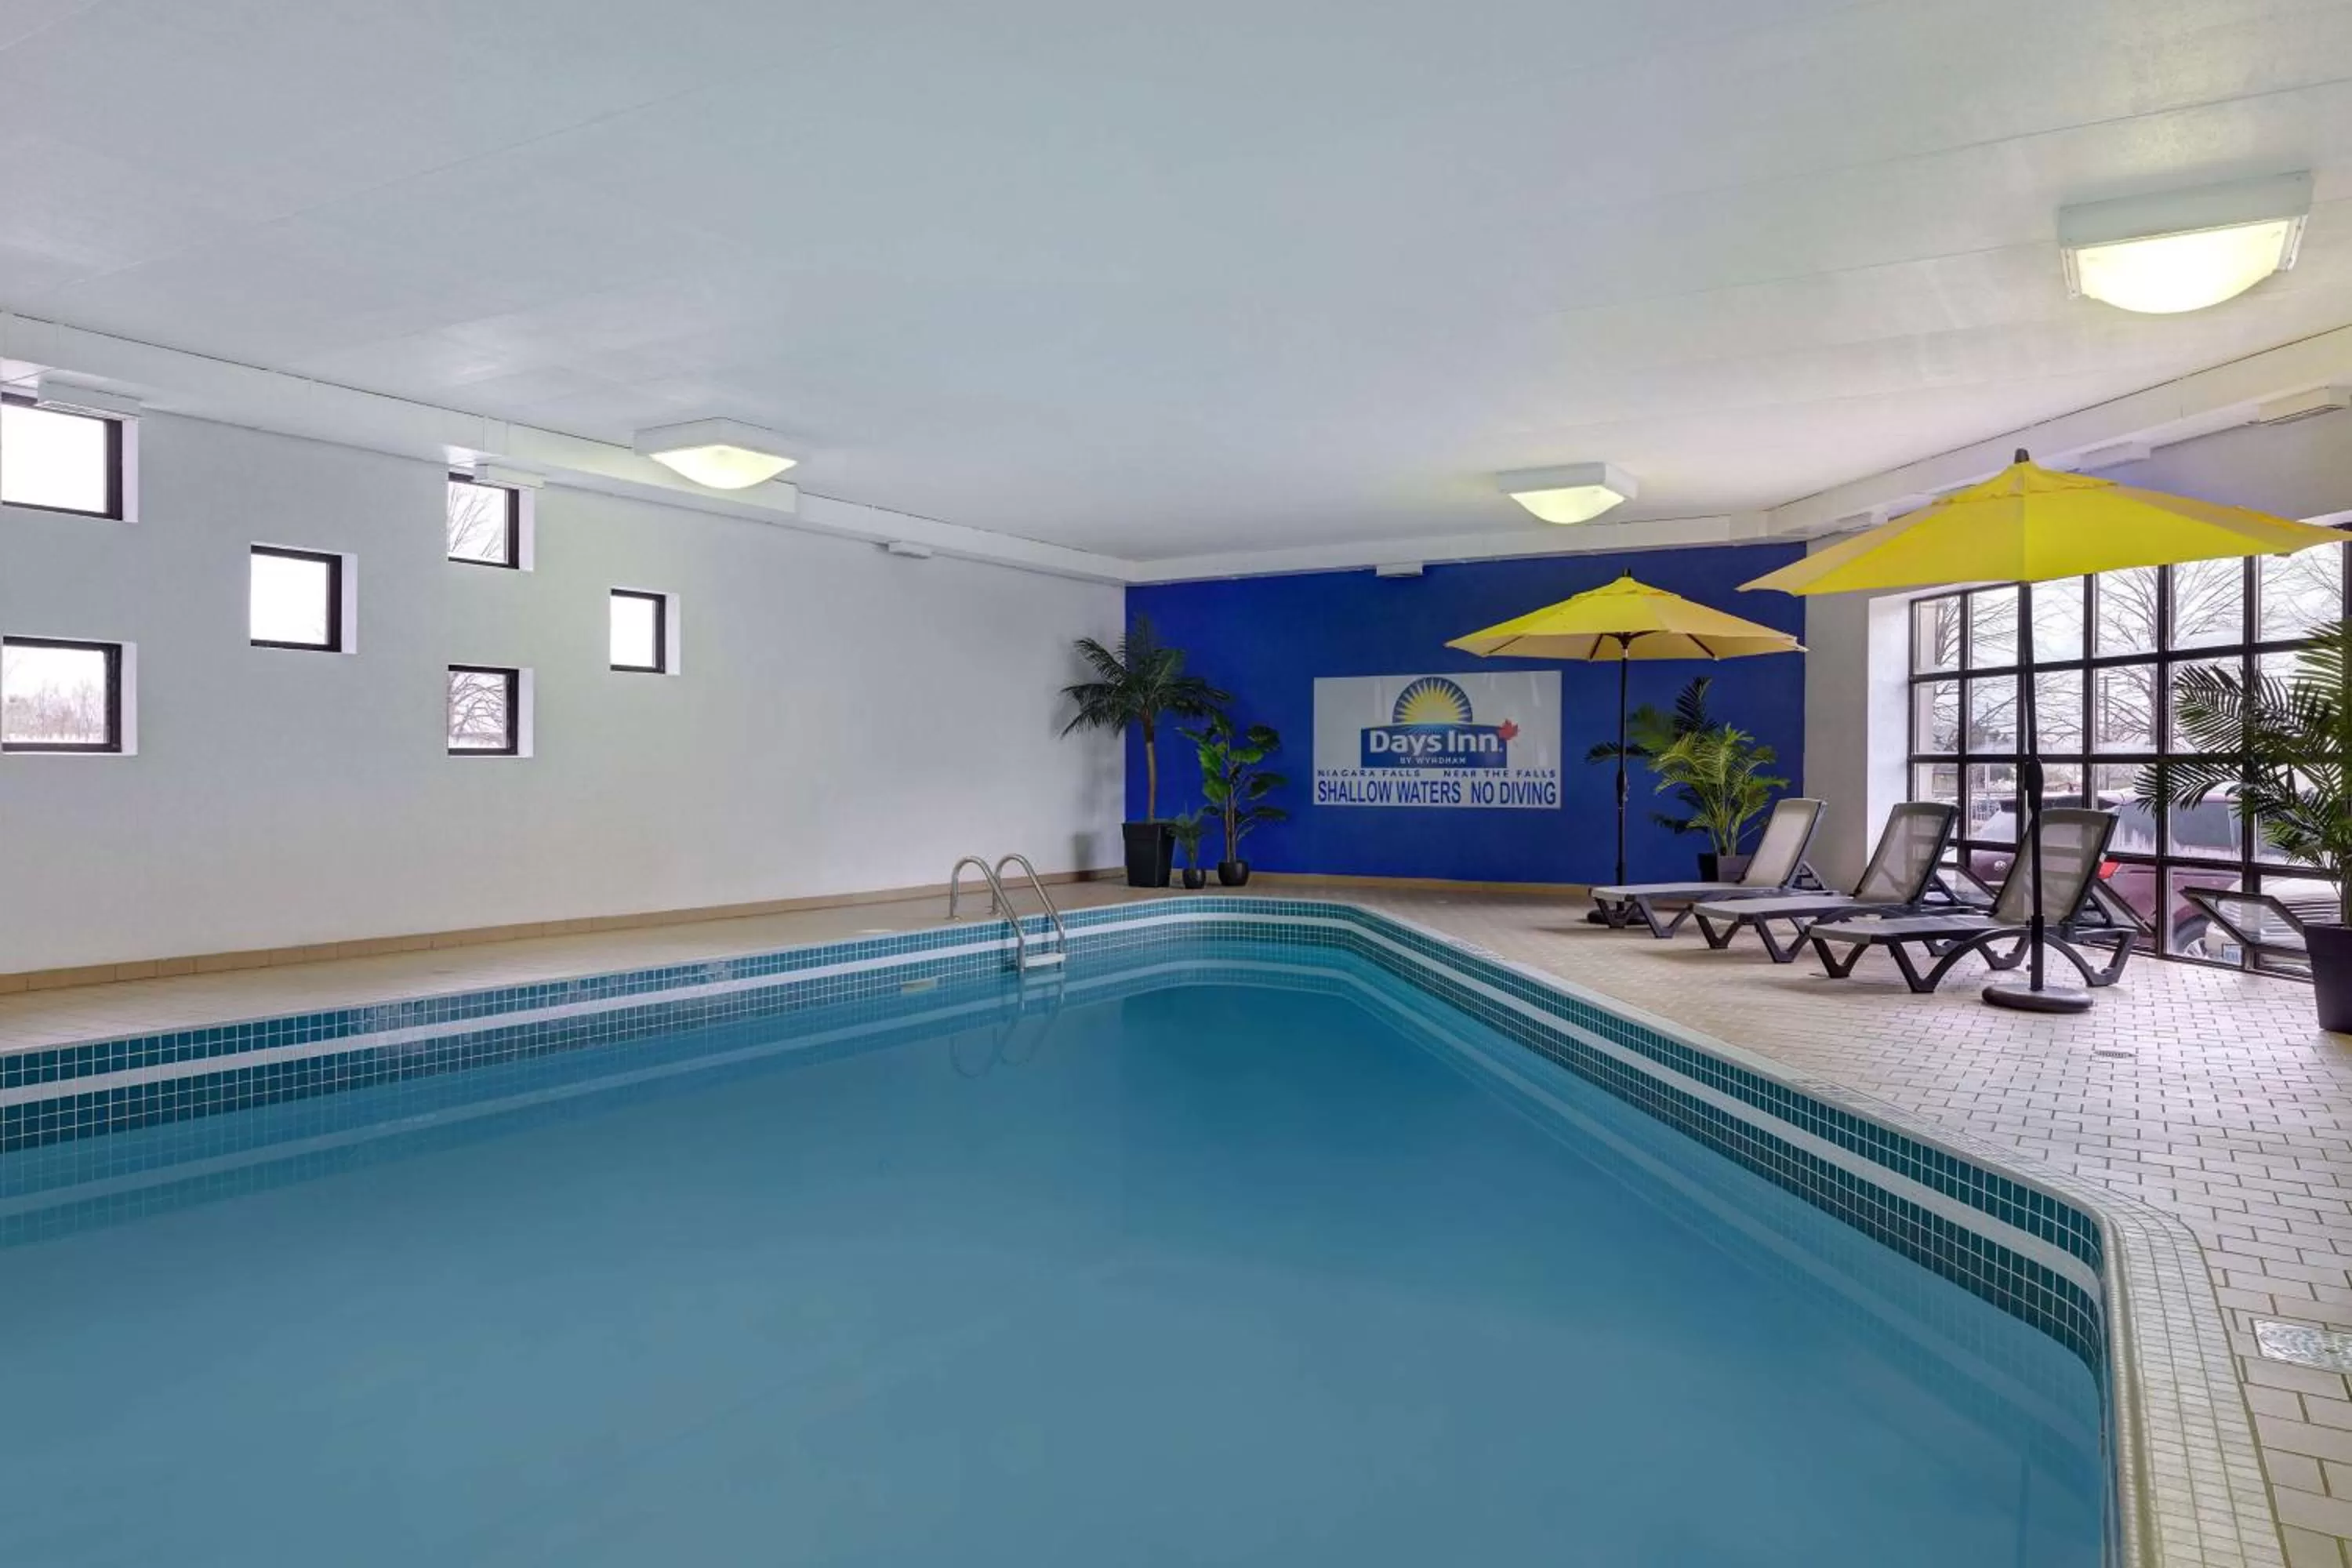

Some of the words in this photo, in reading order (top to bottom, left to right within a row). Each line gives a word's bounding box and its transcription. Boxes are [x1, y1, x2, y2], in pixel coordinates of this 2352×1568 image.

[1370, 730, 1443, 757] Days
[1417, 756, 1467, 764] WYNDHAM
[1517, 769, 1556, 778] FALLS
[1318, 780, 1392, 803] SHALLOW
[1397, 780, 1461, 804] WATERS
[1471, 781, 1494, 804] NO
[1500, 781, 1556, 804] DIVING
